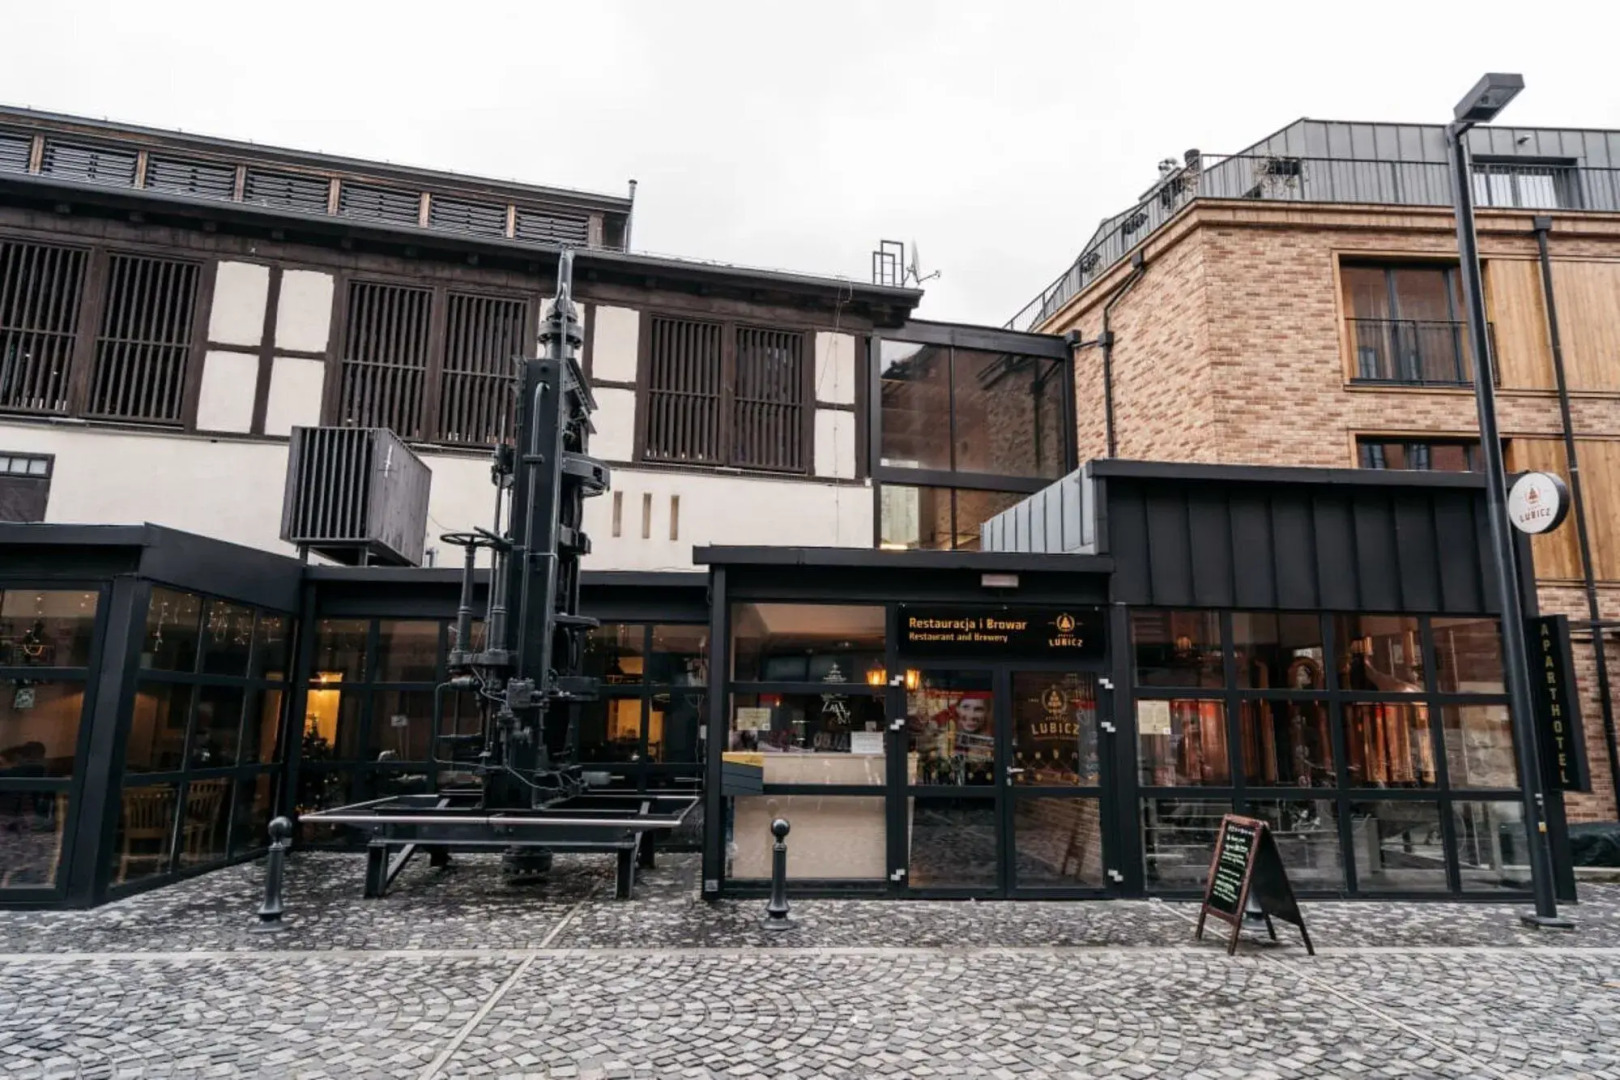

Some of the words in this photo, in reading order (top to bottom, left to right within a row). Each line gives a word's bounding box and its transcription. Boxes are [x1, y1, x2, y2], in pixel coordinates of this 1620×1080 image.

[1519, 507, 1551, 523] LUBICZ
[908, 617, 976, 631] Restauracja
[979, 617, 984, 629] i
[986, 618, 1028, 630] Browar
[908, 632, 954, 642] Restaurant
[956, 632, 972, 642] and
[974, 633, 1008, 644] Brewery
[1048, 638, 1083, 648] LUBICZ
[1540, 622, 1569, 784] APARTHOTEL
[1031, 722, 1080, 736] LUBICZ
